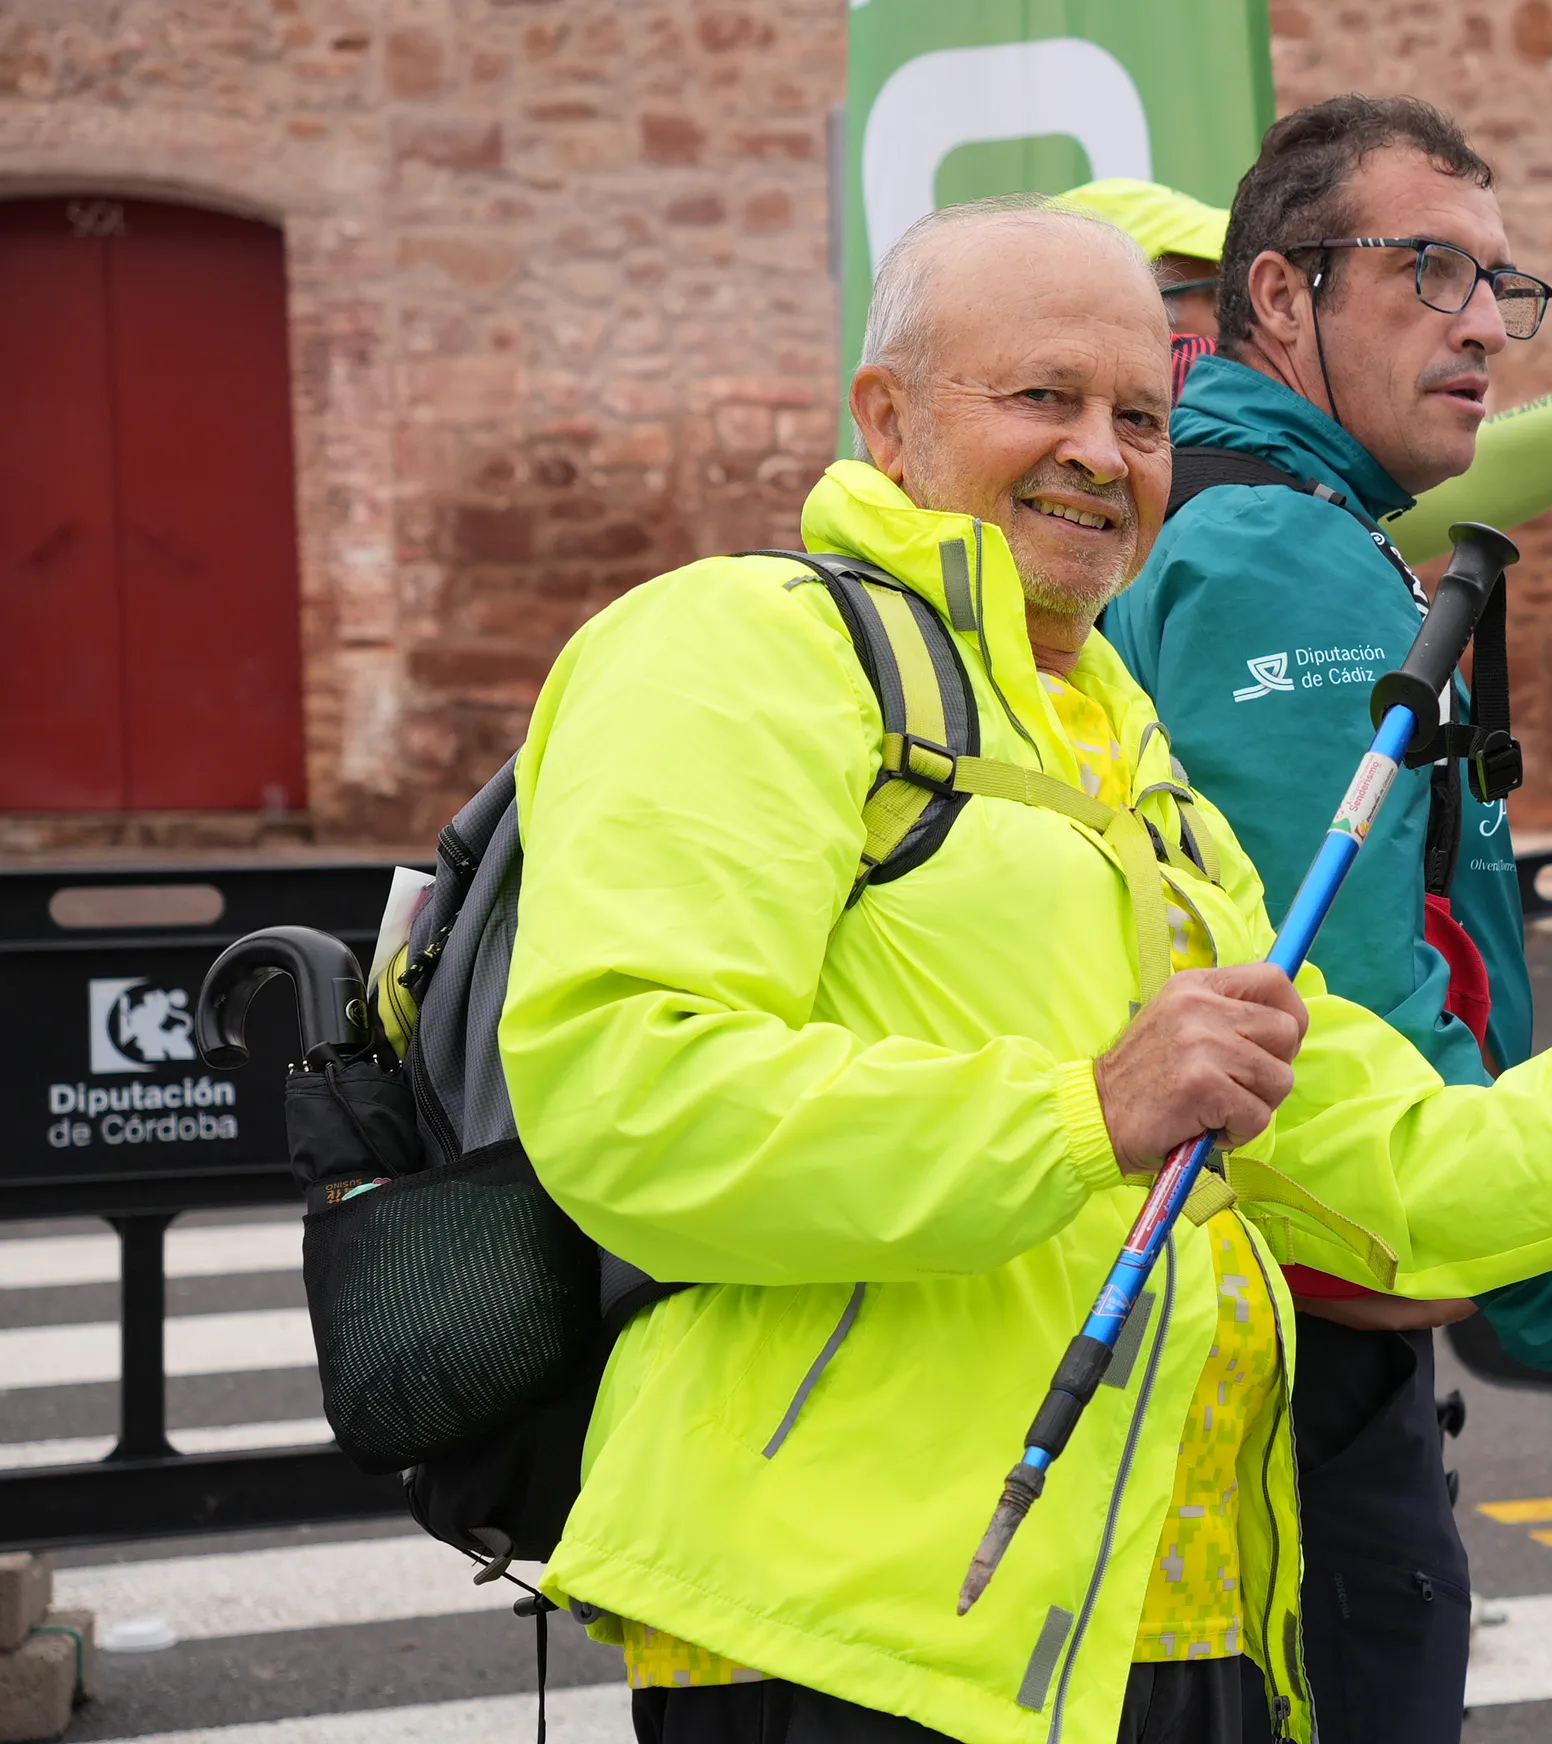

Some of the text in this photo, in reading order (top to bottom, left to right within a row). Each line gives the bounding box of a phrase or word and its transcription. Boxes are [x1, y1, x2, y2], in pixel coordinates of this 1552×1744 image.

[1295, 645, 1385, 666] Diputación
[1301, 667, 1376, 689] de Cádiz
[1349, 761, 1381, 812] Senderismo
[48, 1076, 236, 1118] Diputación
[47, 1109, 238, 1148] de Córdoba
[325, 1178, 362, 1191] SUSINO
[1335, 1573, 1350, 1620] QUECHUA
